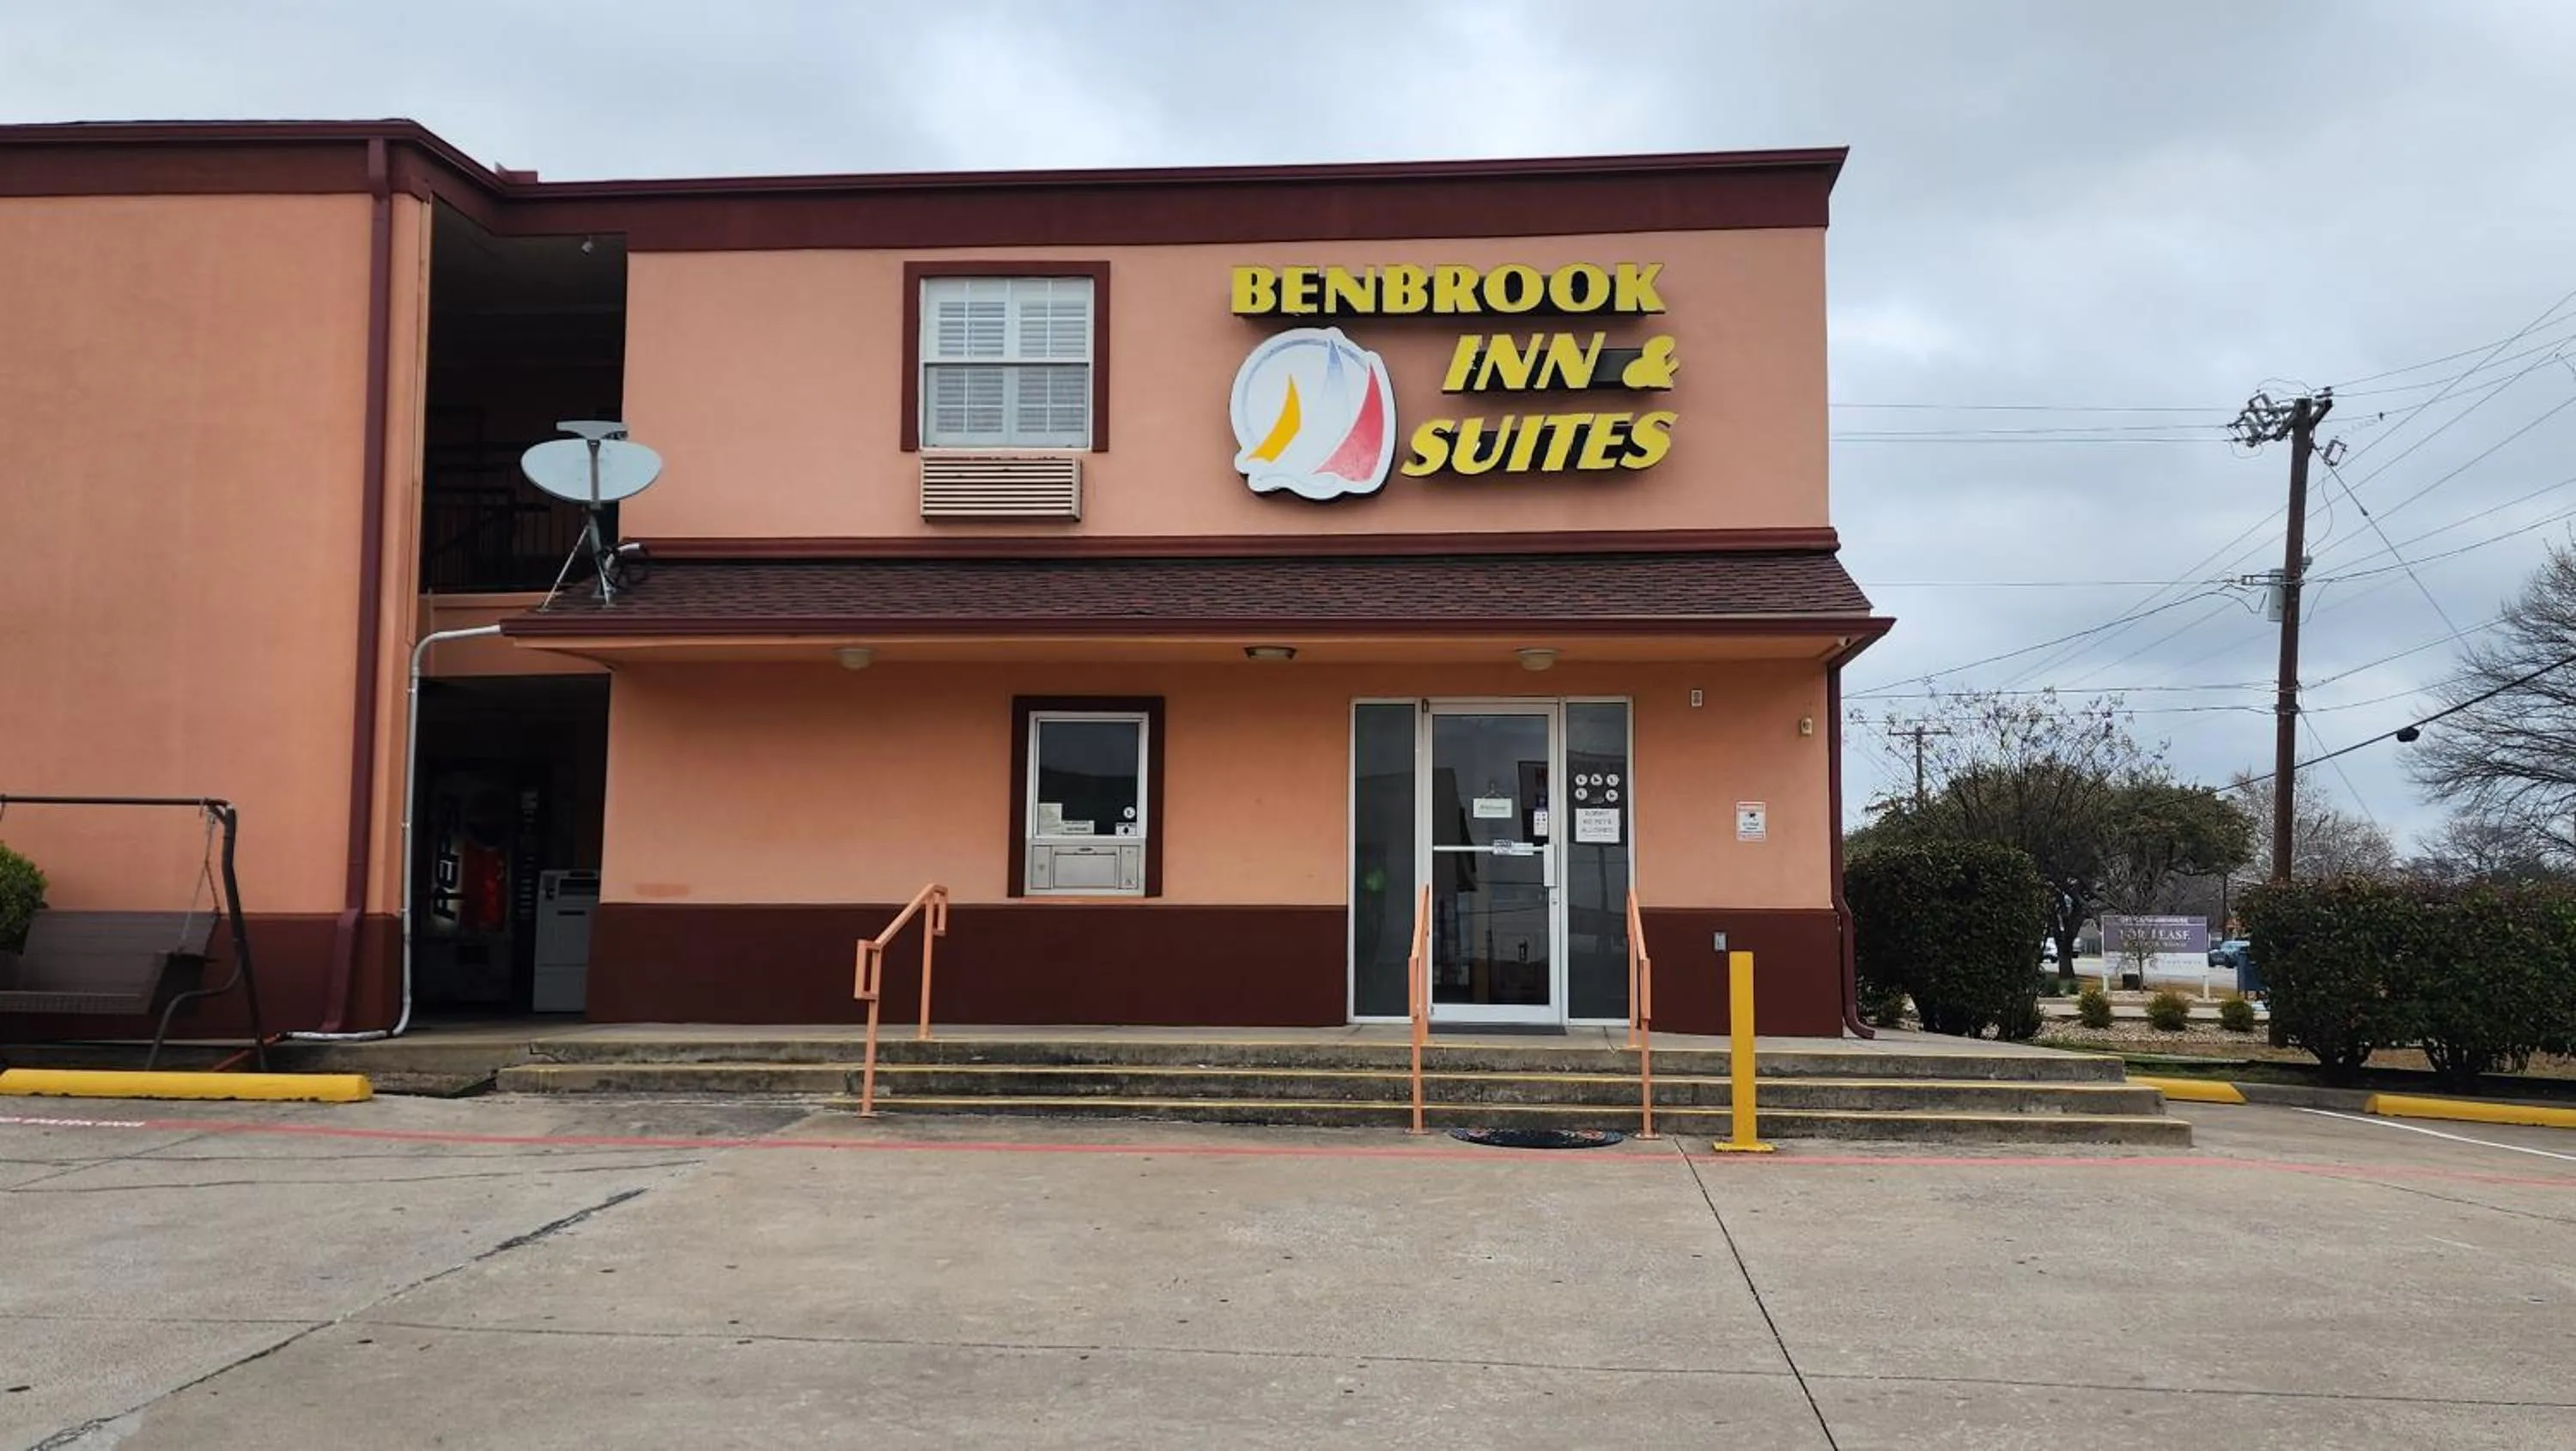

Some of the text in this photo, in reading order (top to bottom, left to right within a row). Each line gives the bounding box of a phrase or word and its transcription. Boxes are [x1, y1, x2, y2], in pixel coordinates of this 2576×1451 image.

[1230, 263, 1666, 315] BENBROOK
[1442, 331, 1680, 392] INN &
[1401, 411, 1680, 477] SUITES
